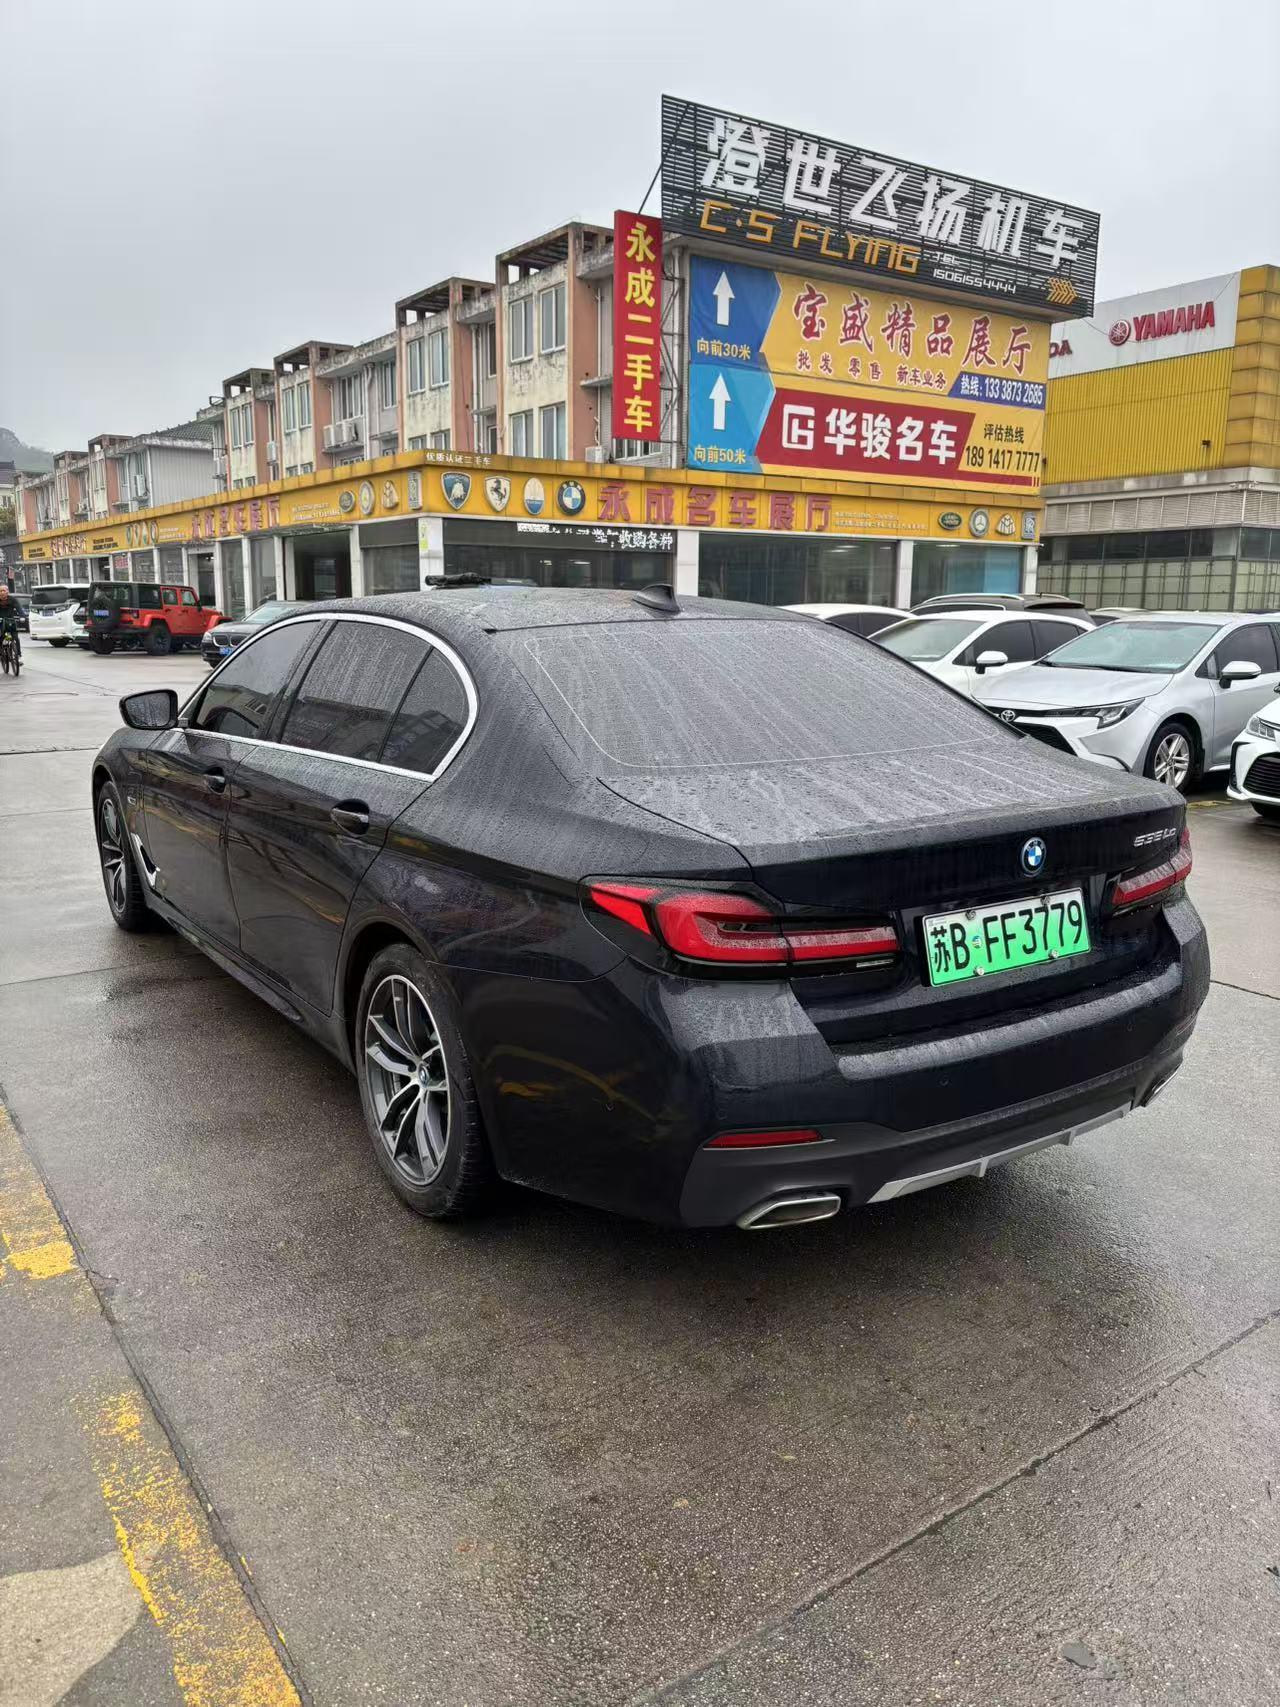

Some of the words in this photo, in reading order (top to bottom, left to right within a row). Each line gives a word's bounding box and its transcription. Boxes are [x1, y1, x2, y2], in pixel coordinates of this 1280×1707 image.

[700, 116, 1084, 268] 澄世飞扬机车
[793, 219, 921, 274] FLYING
[933, 268, 1017, 295] 15061554444
[624, 222, 656, 433] 永成二手车
[793, 282, 1032, 376] 宝盛精品展厅
[1132, 301, 1215, 342] YAMAHA
[696, 337, 751, 361] 向前30米
[896, 364, 948, 391] 新车业务
[693, 443, 746, 465] 向前50米
[824, 408, 958, 465] 华骏名车
[984, 423, 1024, 444] 评估热线
[965, 445, 985, 468] 189
[988, 448, 1013, 471] 1417
[1016, 451, 1040, 473] 7777
[597, 481, 832, 531] 永成名车展厅
